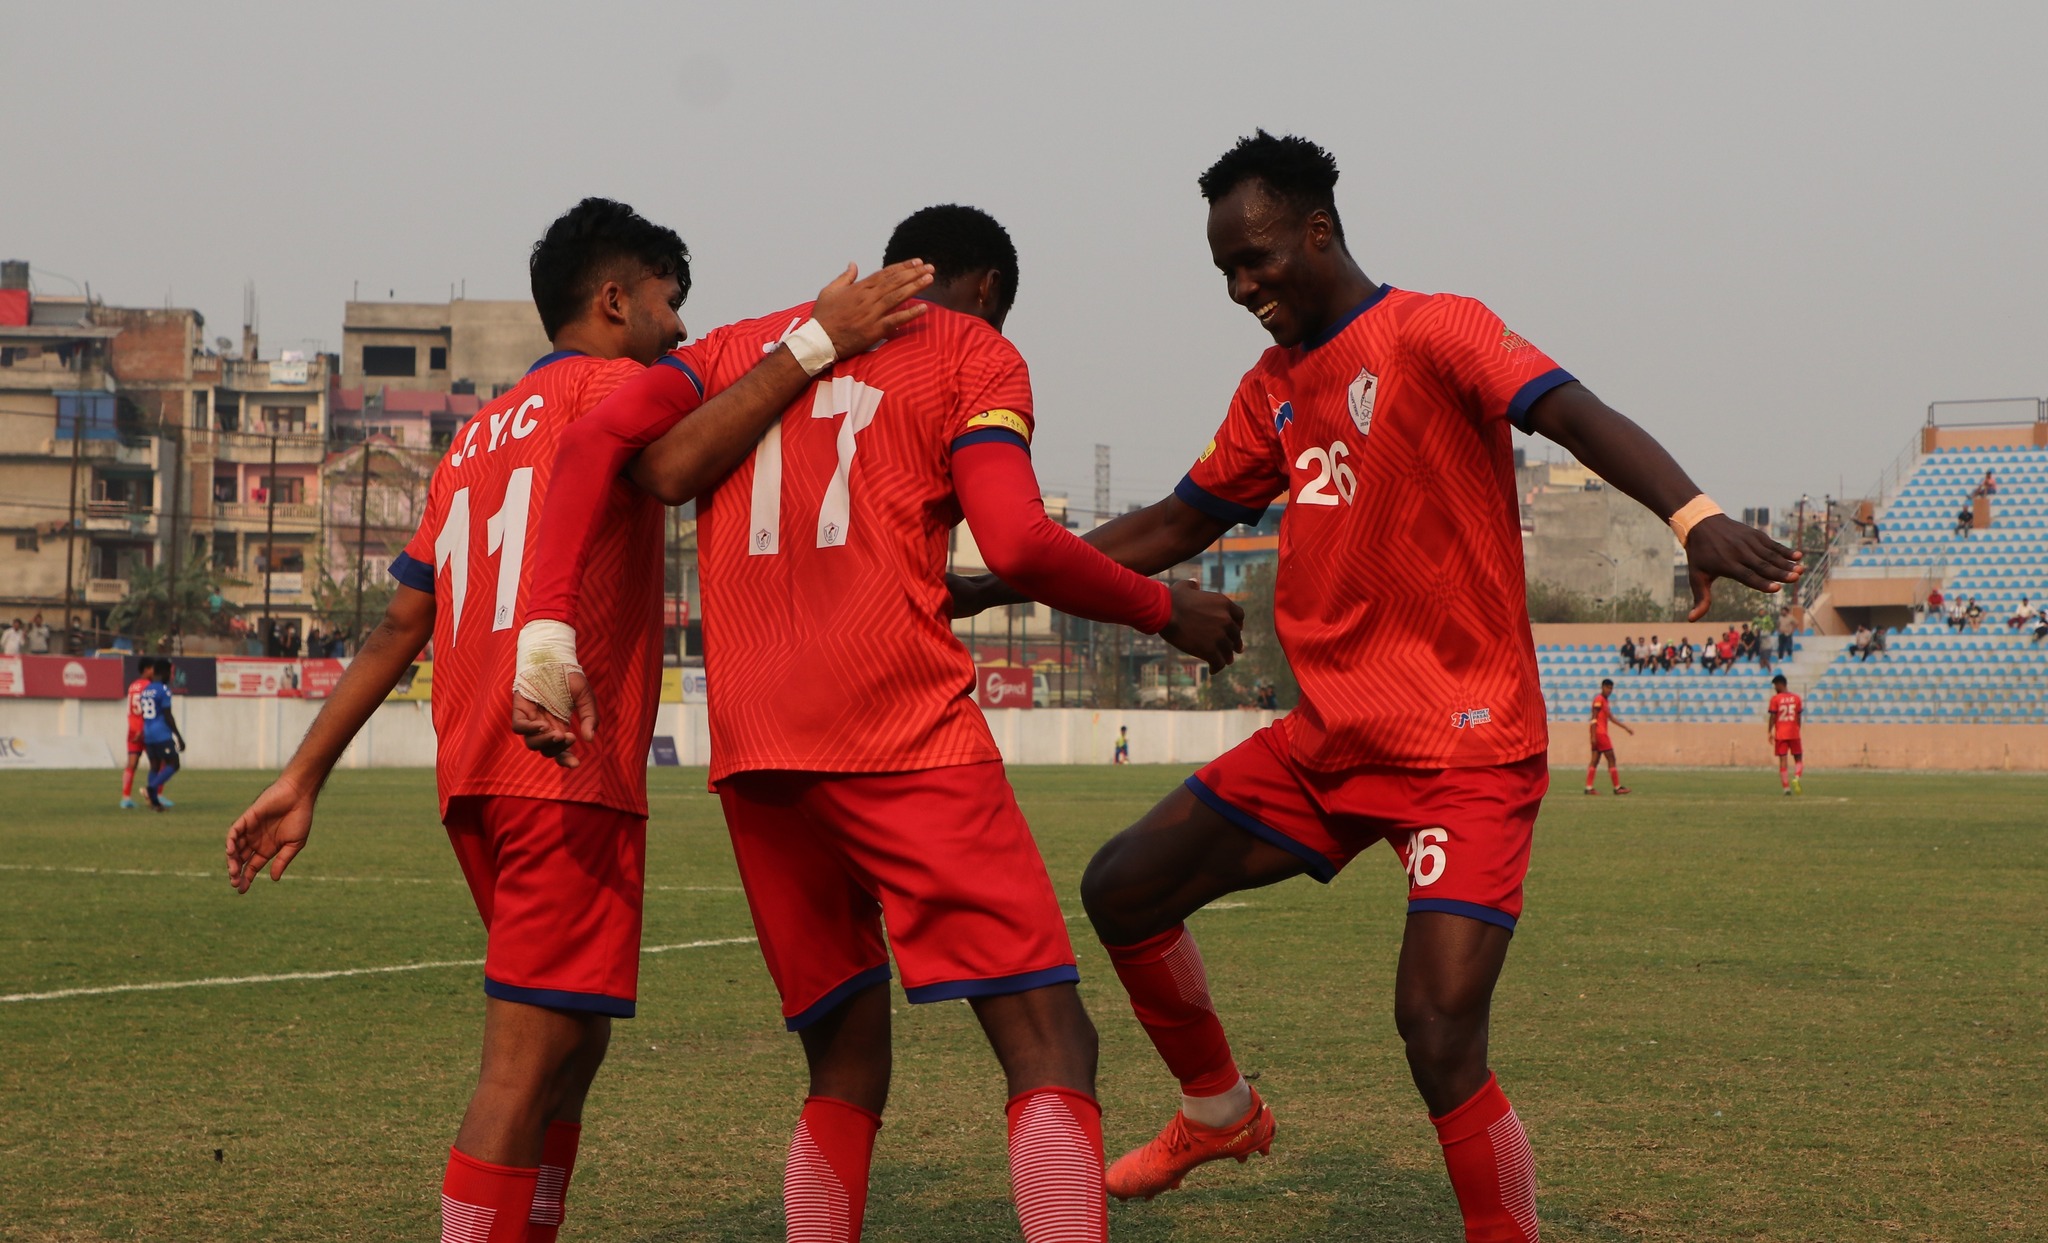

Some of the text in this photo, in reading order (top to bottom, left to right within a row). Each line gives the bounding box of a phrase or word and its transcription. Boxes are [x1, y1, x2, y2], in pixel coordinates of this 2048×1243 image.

[749, 375, 885, 556] 17
[1295, 440, 1358, 507] 26
[435, 467, 534, 648] 11
[1778, 704, 1797, 722] 25
